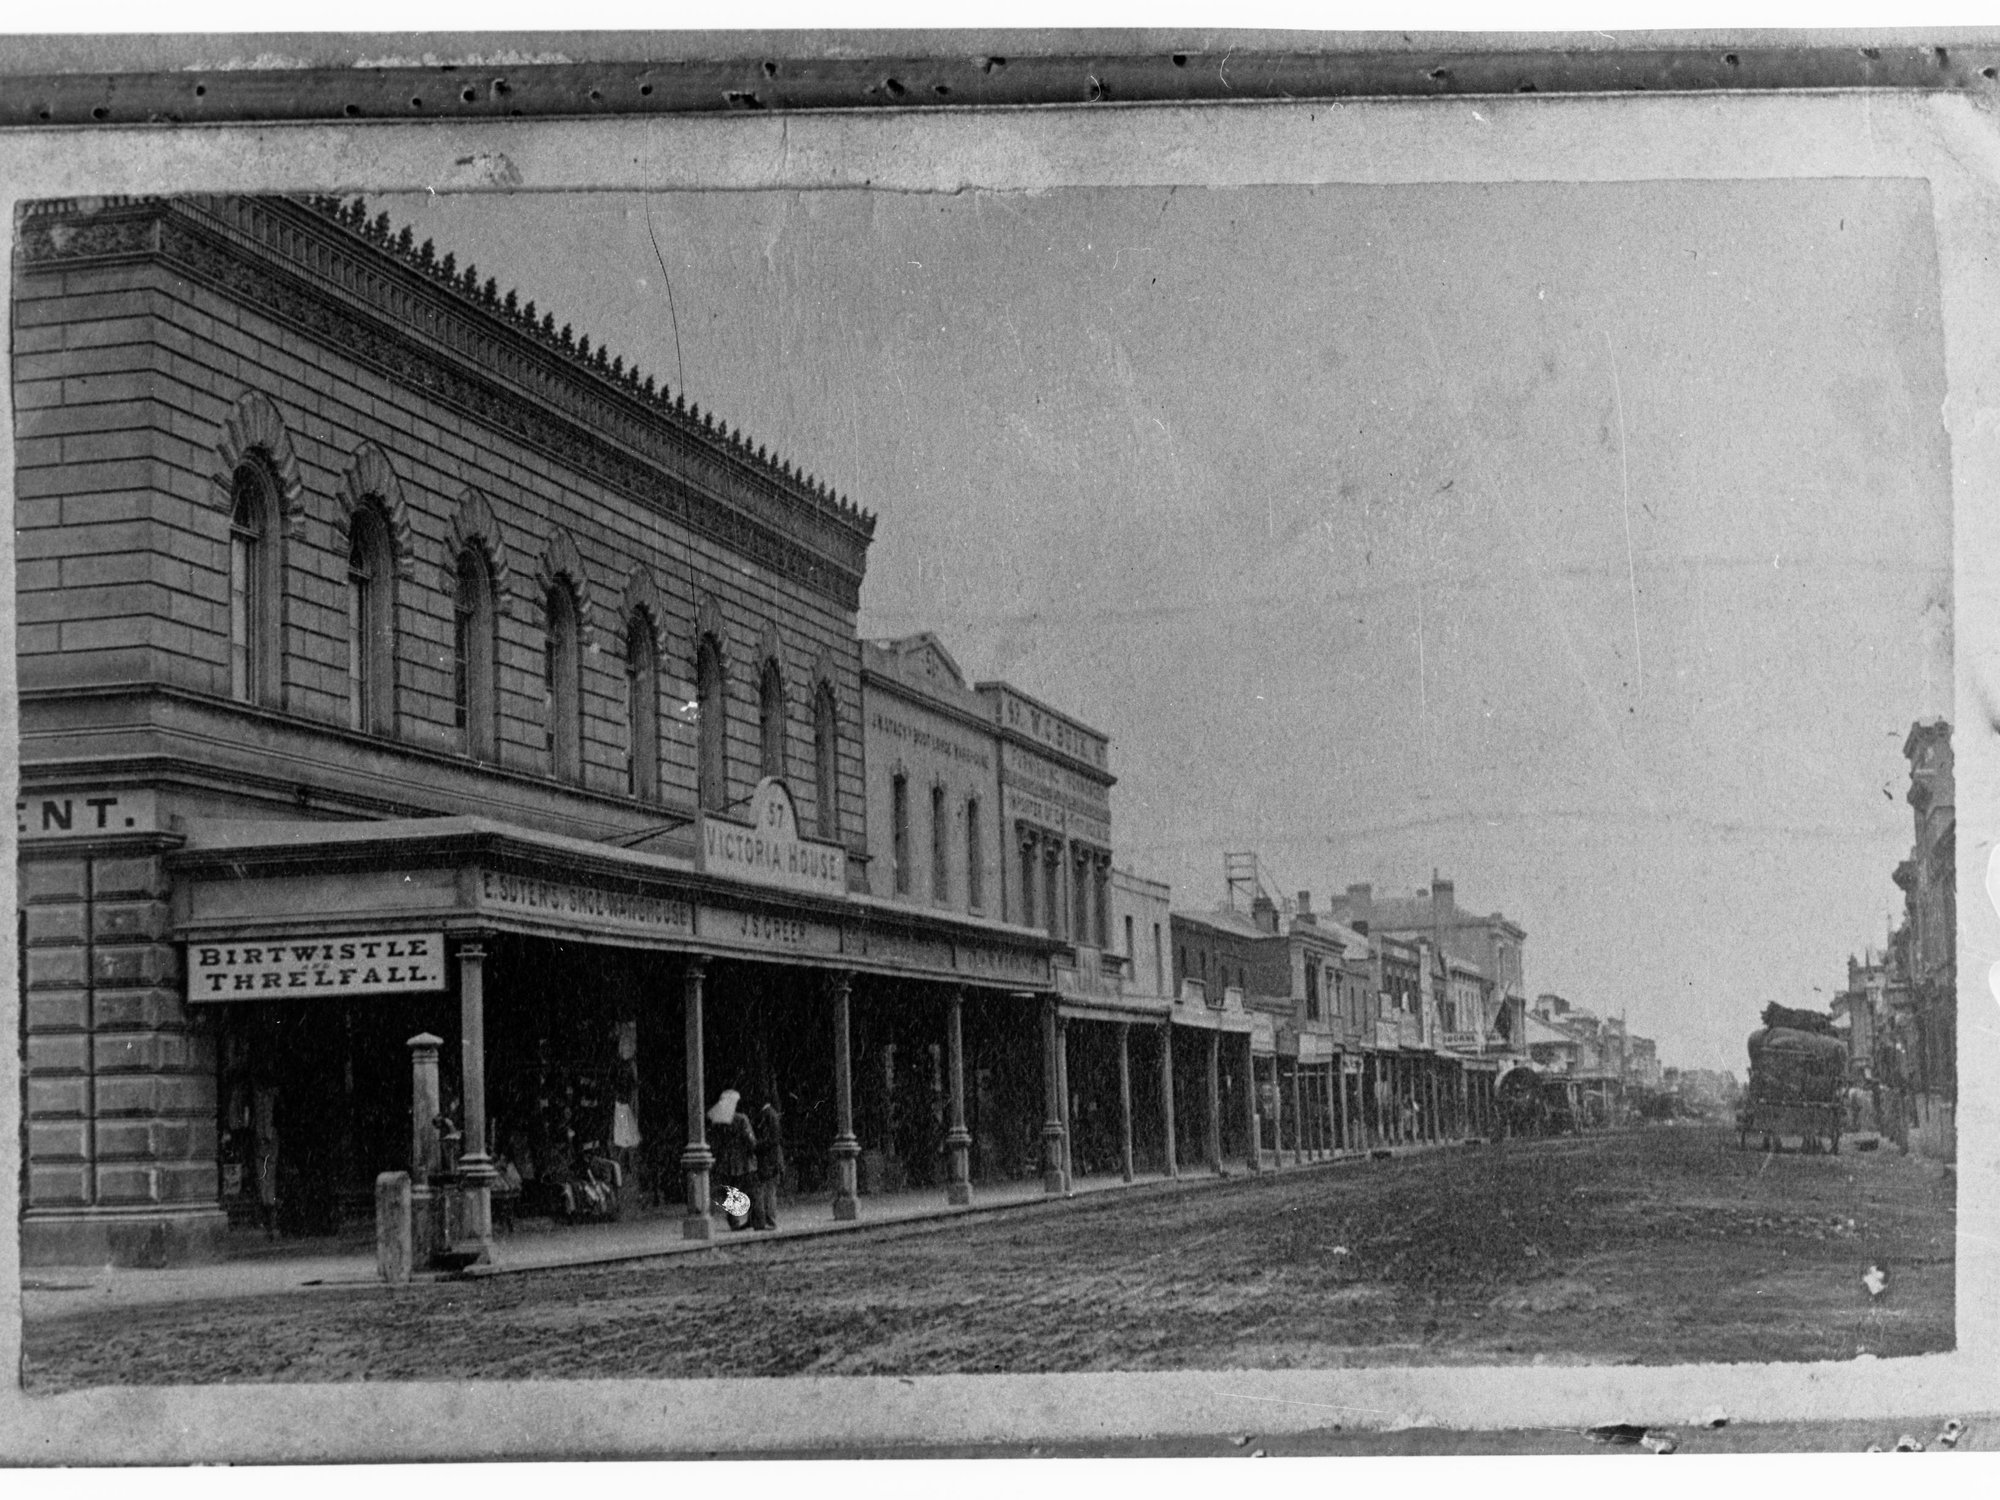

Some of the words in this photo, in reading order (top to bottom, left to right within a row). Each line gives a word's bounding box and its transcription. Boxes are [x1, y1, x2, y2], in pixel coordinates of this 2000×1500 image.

[705, 824, 784, 871] VICTORIA
[199, 939, 429, 967] BIRTWISTLE
[205, 965, 437, 991] THRELFALL.
